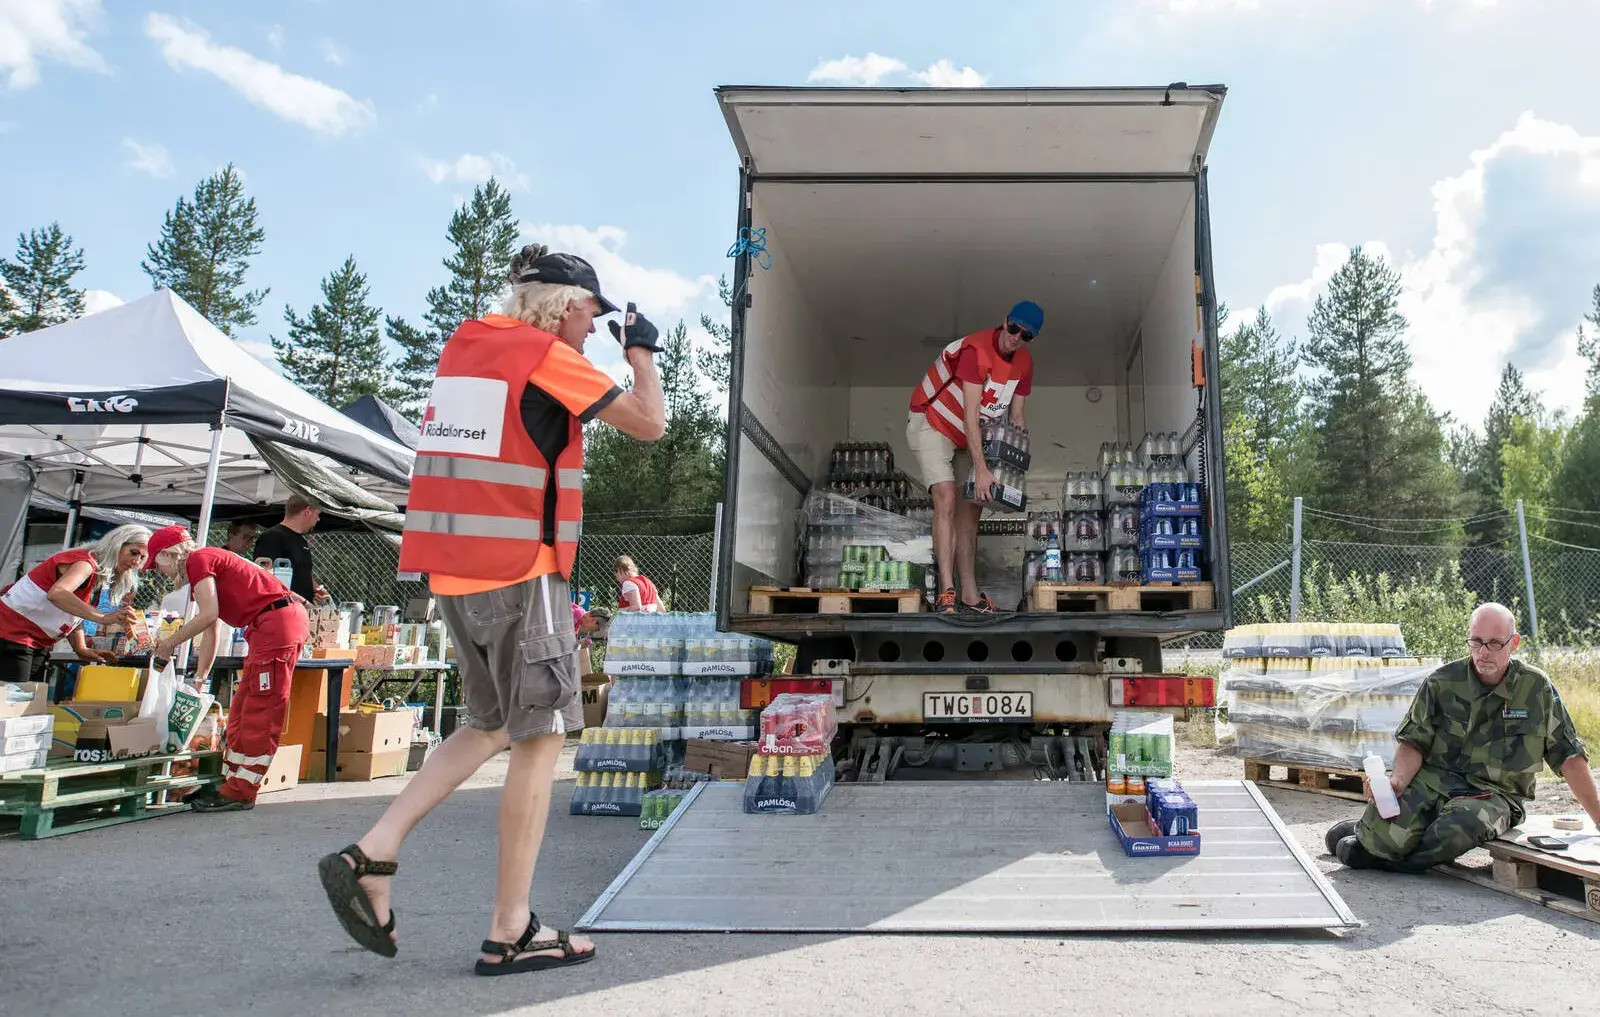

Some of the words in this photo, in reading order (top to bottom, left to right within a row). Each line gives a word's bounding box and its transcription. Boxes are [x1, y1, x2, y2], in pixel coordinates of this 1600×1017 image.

[929, 696, 969, 715] TWG
[986, 696, 1027, 715] 084
[761, 744, 793, 753] clean
[757, 798, 796, 809] RAMLÖSA
